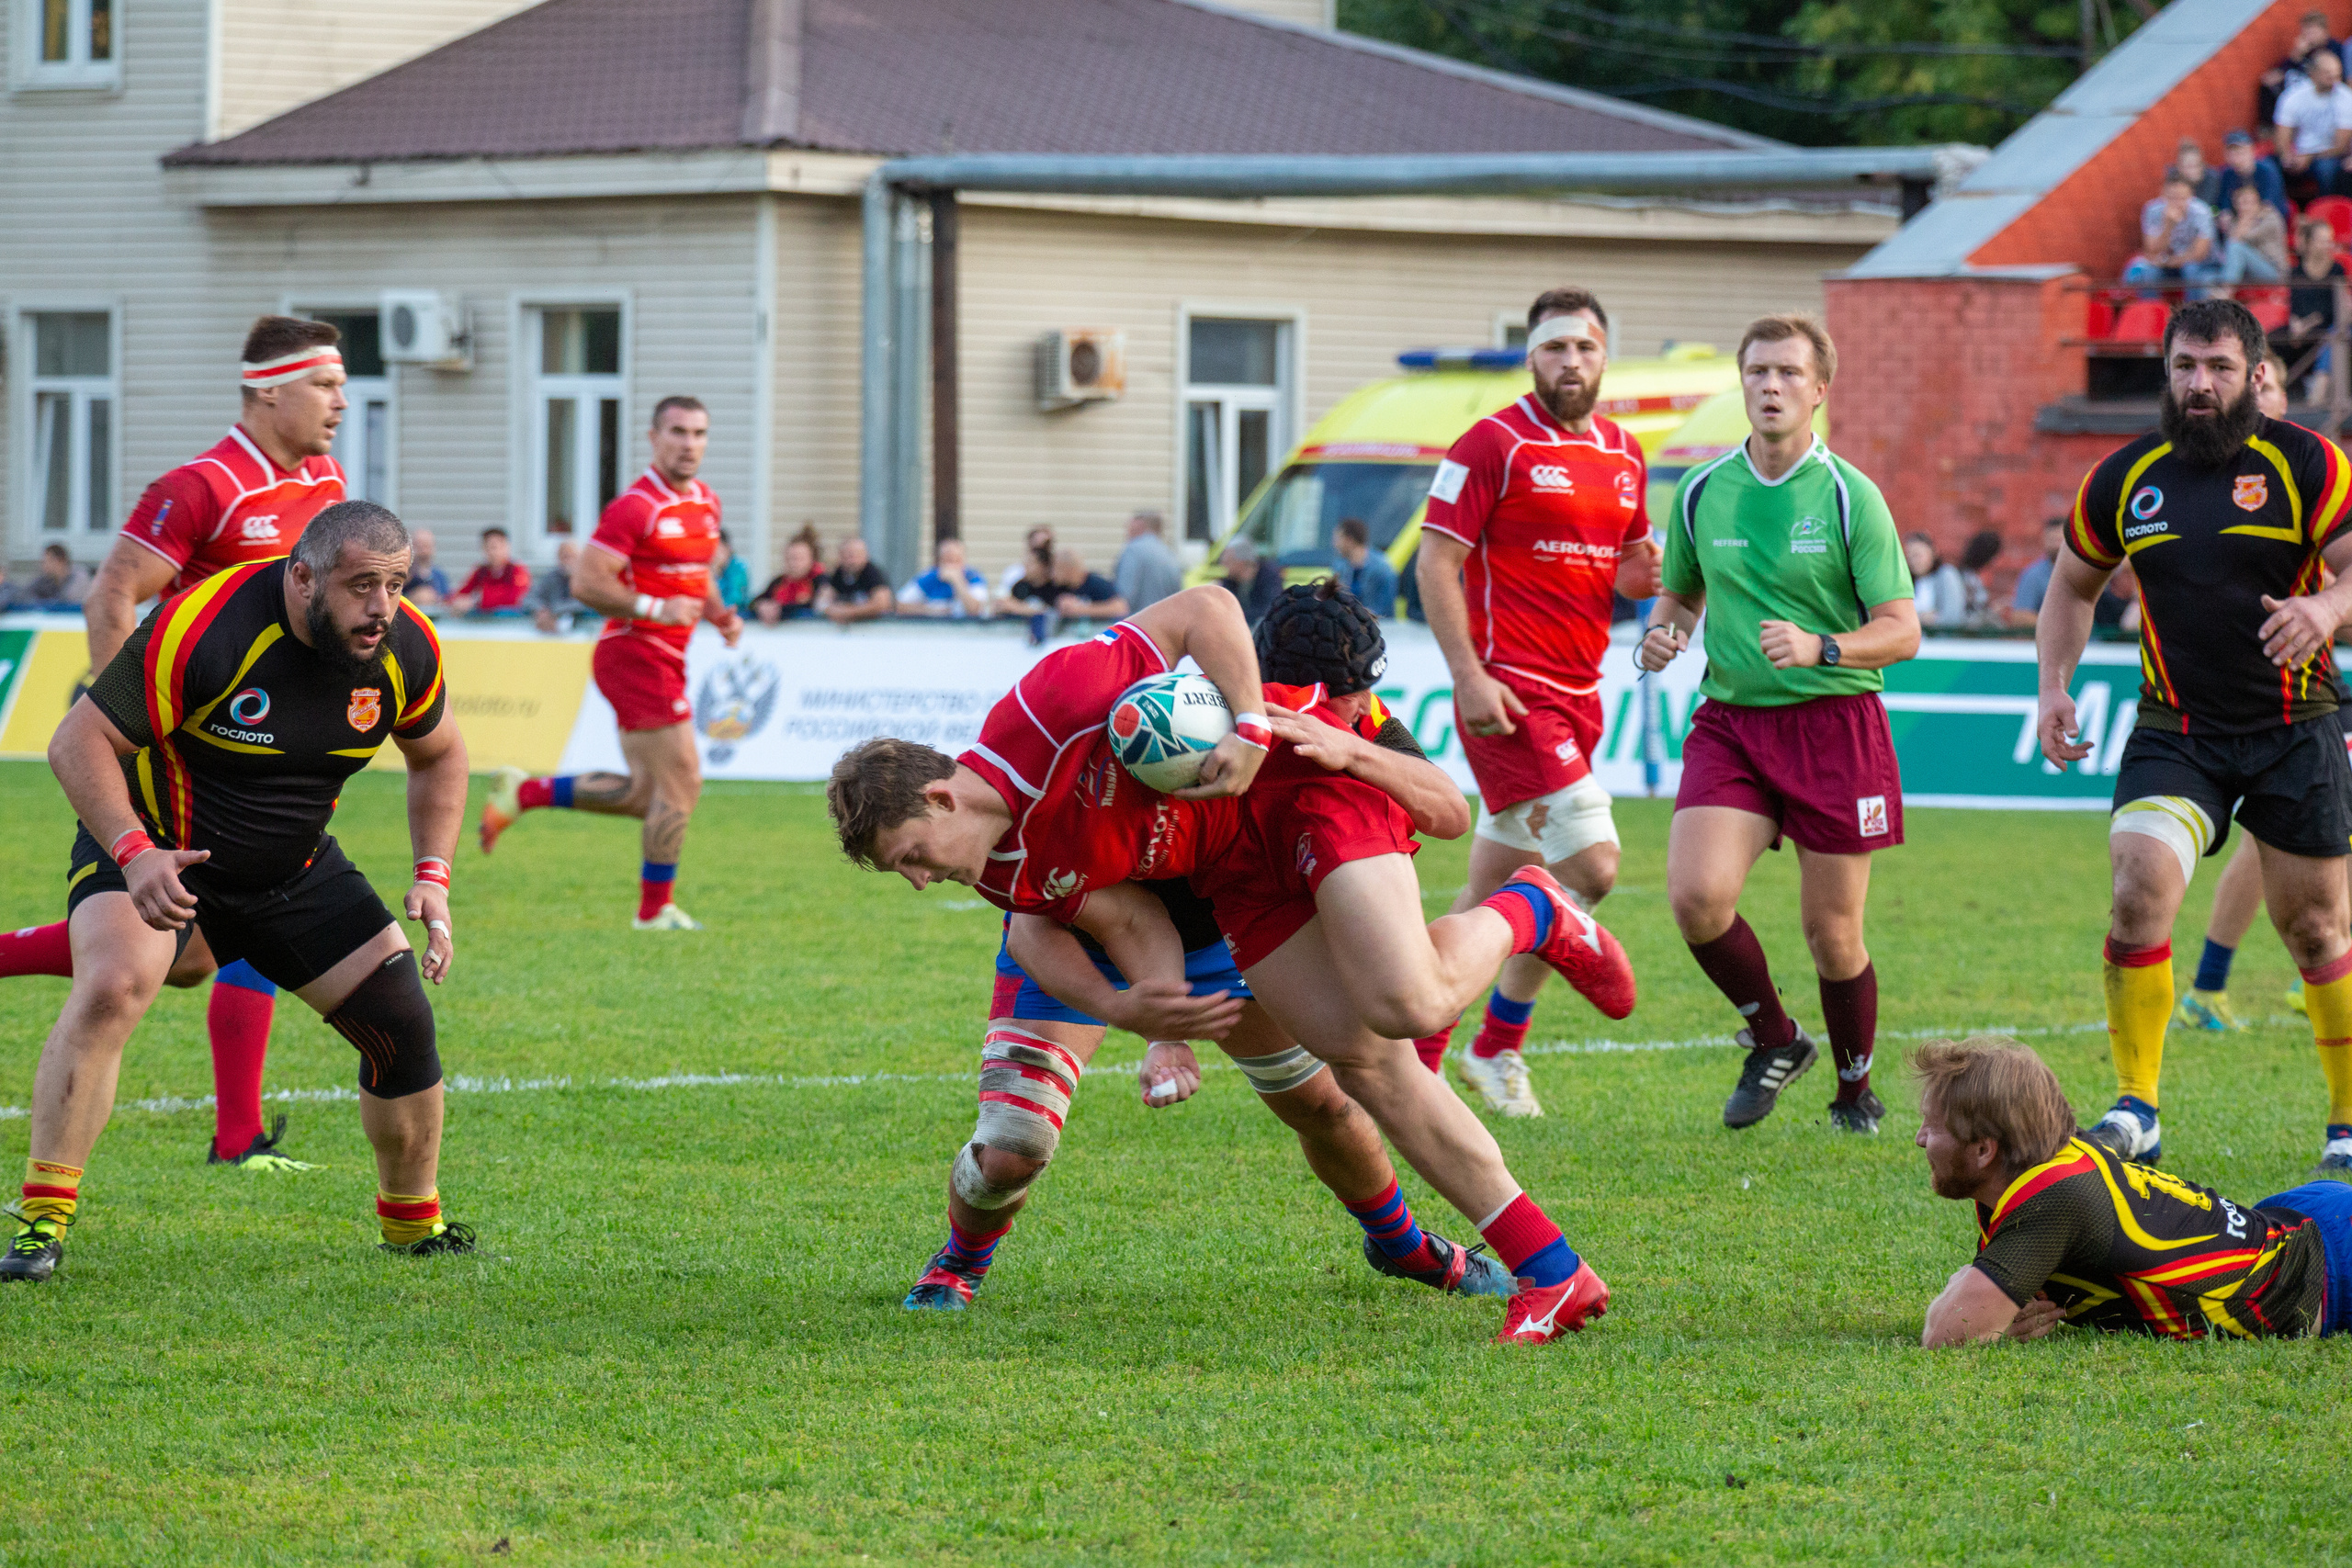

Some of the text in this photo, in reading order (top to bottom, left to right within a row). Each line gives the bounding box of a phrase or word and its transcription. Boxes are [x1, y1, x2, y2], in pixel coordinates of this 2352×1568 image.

[2125, 521, 2168, 539] ГОСЛОТО
[1713, 538, 1749, 547] REFEREE
[1182, 692, 1229, 709] BERT
[209, 724, 275, 744] ГОСЛОТО
[1101, 762, 1117, 807] Russia
[1139, 800, 1170, 873] OFLOT
